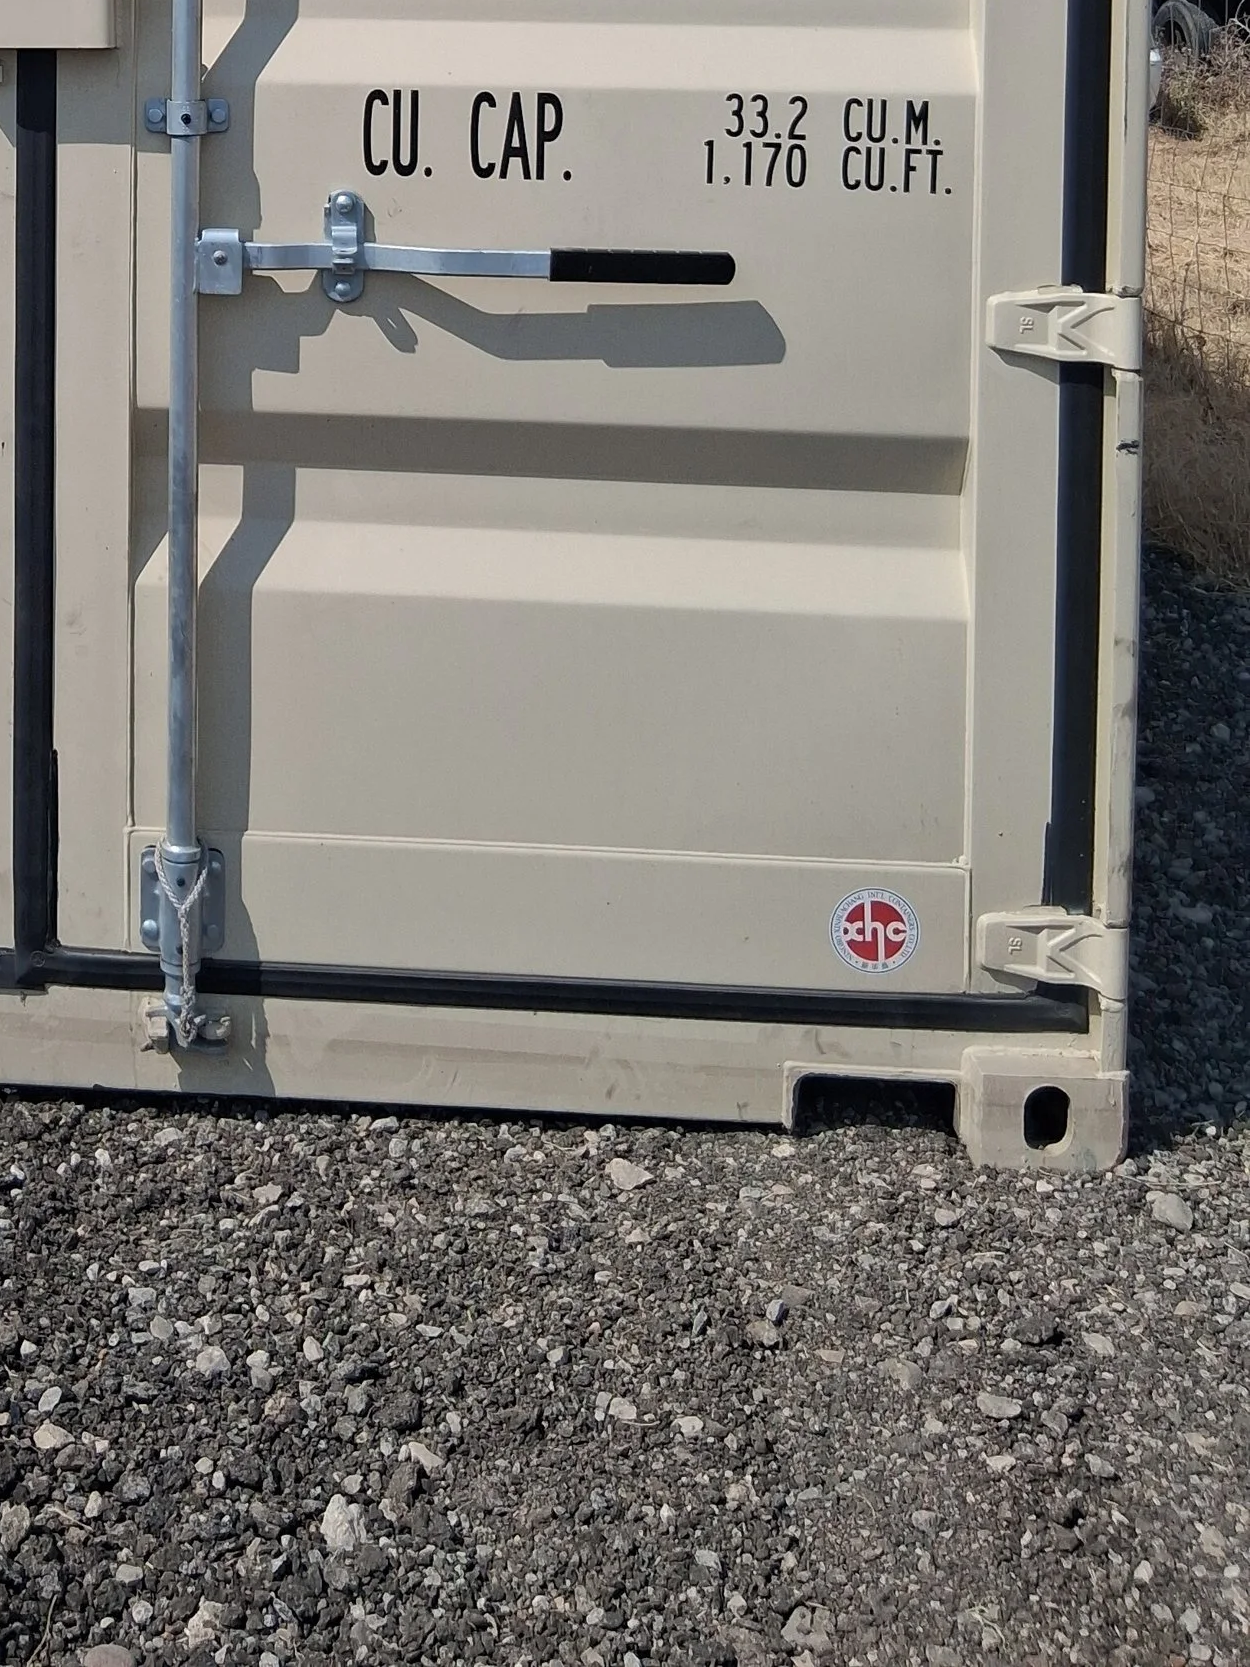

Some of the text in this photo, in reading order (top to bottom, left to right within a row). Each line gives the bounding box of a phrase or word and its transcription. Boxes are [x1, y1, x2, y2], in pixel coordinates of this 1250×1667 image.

[362, 88, 942, 182] CU. CAP. 33.2 CU.M.
[703, 139, 954, 195] 1,170 CU.FT.
